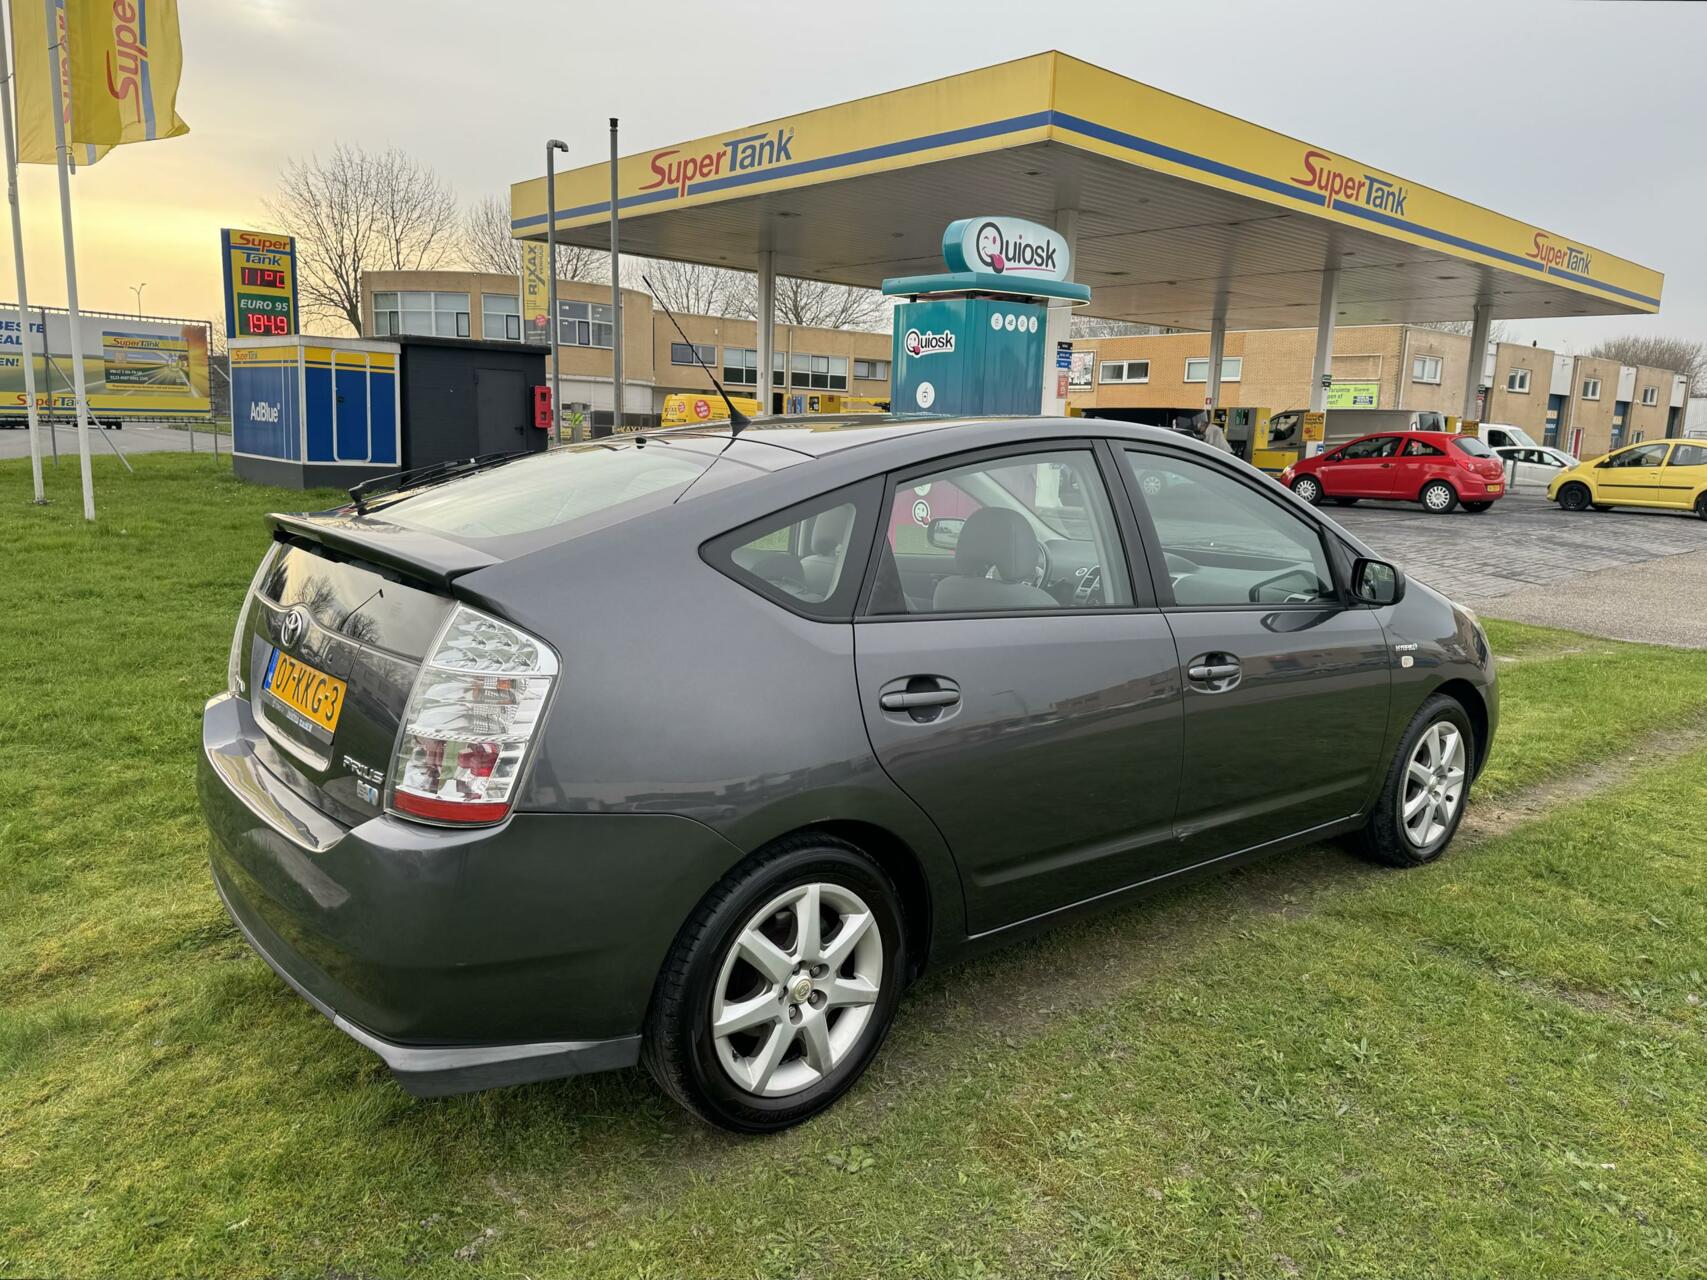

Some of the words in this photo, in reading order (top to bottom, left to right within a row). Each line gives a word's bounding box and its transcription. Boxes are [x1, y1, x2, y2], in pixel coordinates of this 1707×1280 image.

[639, 129, 794, 198] SuperTank
[1290, 150, 1407, 217] SuperTank
[231, 233, 289, 252] Super
[976, 222, 1056, 274] Quiosk
[1526, 232, 1592, 275] SuperTank
[241, 252, 281, 266] Tank
[240, 299, 272, 310] EURO
[275, 302, 288, 311] 95
[113, 337, 160, 349] SuperTank
[906, 330, 953, 355] Quiosk
[9, 393, 90, 408] SperTak
[250, 401, 279, 423] AdBlue
[276, 657, 339, 722] 07-KKG-3
[343, 755, 384, 784] PRIUS
